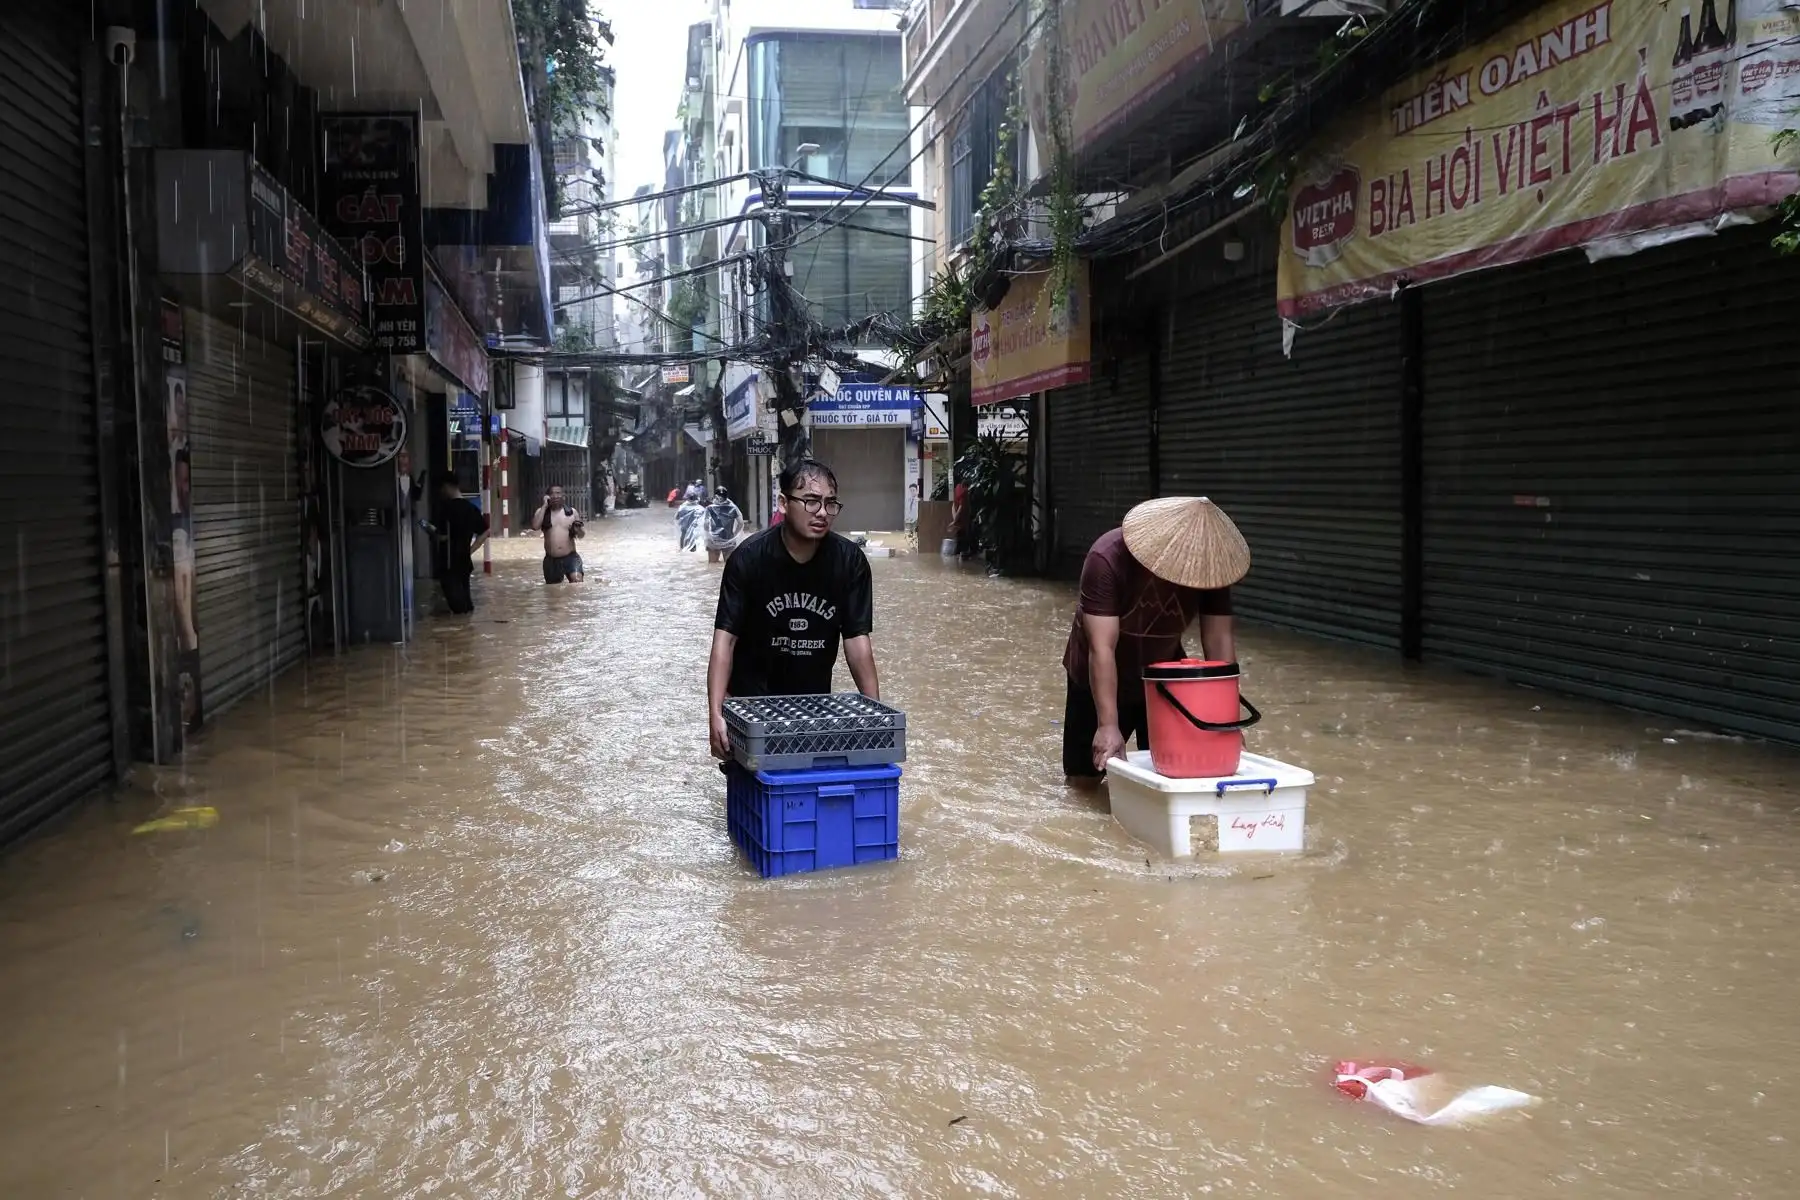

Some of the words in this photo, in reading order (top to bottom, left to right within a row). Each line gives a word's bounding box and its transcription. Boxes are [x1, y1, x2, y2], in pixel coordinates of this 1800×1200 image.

[1392, 66, 1474, 137] TIẾN
[1479, 1, 1613, 96] OANH
[1368, 168, 1416, 238] BIA
[1425, 126, 1481, 219] HƠI
[1492, 90, 1580, 203] VIỆT
[1593, 47, 1661, 164] HÀ
[1312, 222, 1336, 239] BEER
[855, 387, 892, 402] QUYÊN
[895, 389, 910, 401] AN
[811, 412, 840, 423] THUỐC
[842, 411, 858, 423] TỐT
[797, 639, 826, 649] CREEK
